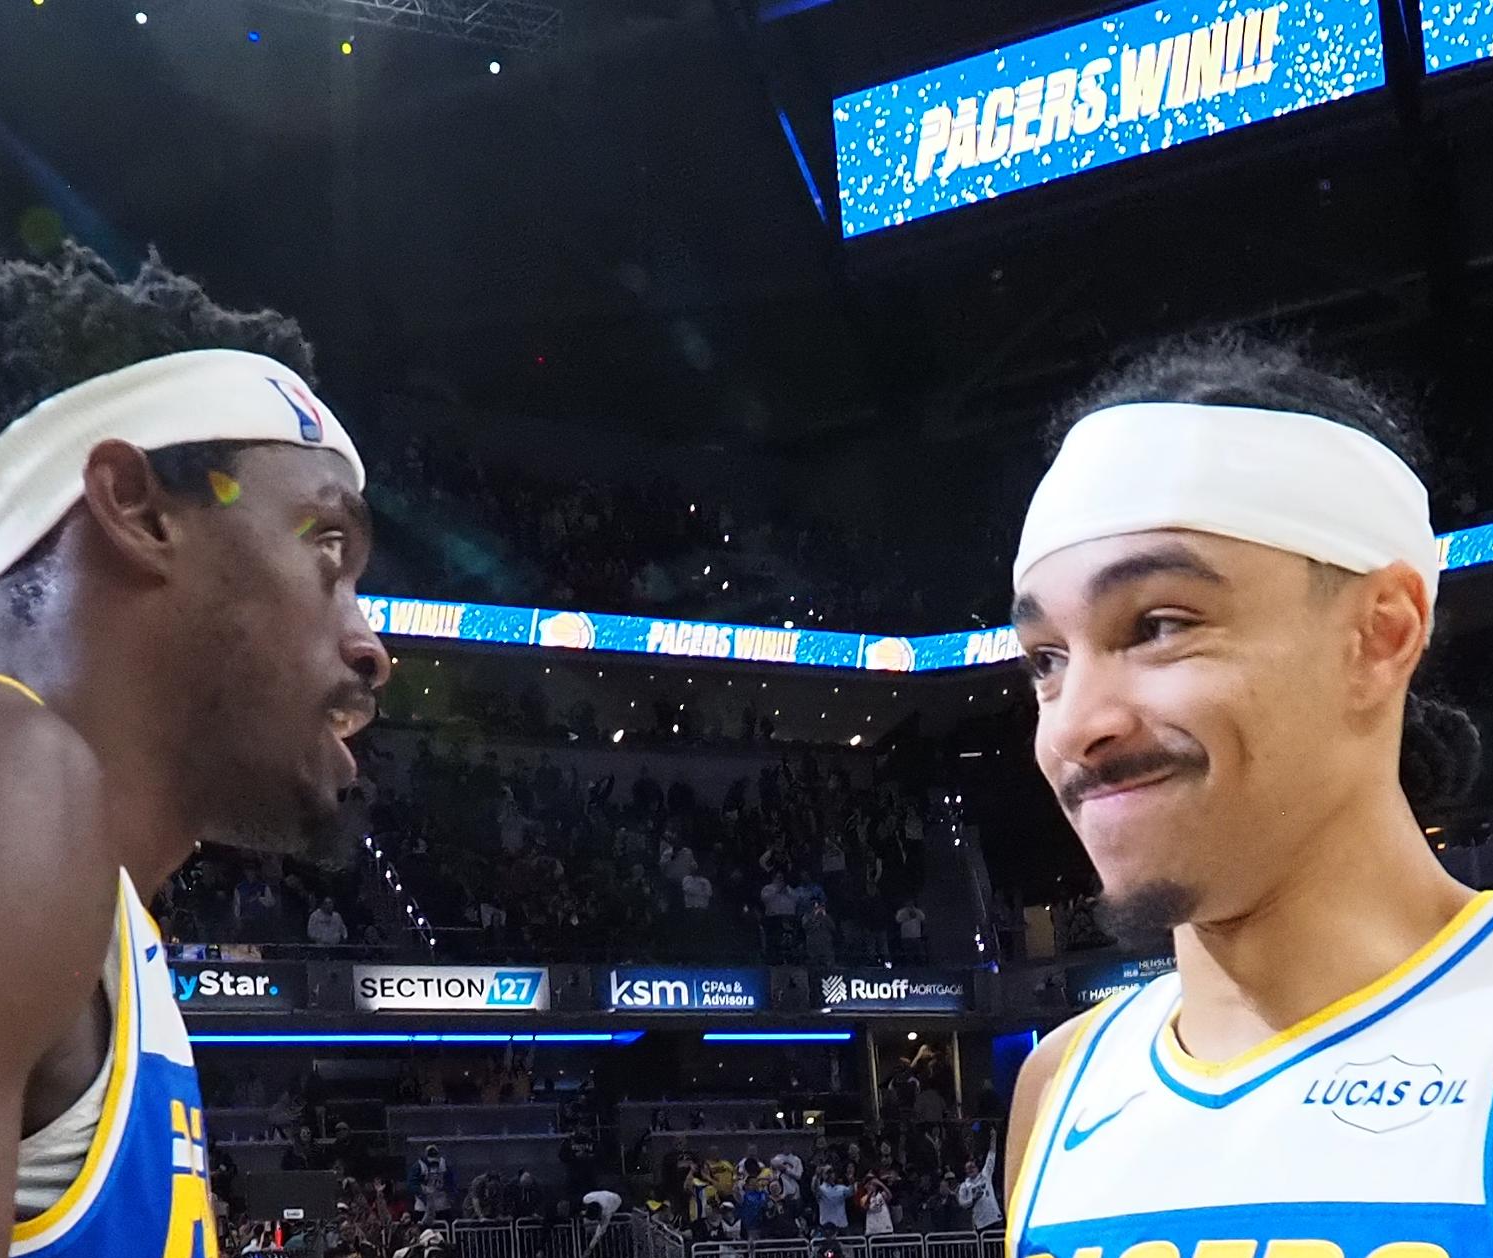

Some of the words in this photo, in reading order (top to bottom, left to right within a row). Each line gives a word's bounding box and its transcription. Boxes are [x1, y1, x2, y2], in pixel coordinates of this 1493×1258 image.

[914, 57, 1111, 183] PACERS
[1118, 6, 1281, 122] WIN!!!
[646, 621, 733, 658] PACERS
[734, 628, 800, 662] WIN!!!
[360, 977, 486, 999] SECTION
[490, 977, 531, 1002] 127
[610, 970, 689, 1006] ksm
[702, 981, 733, 994] CPAs
[702, 993, 755, 1007] Advisors
[851, 979, 909, 1000] Ruoff
[1302, 1079, 1411, 1106] LUCAS
[1419, 1079, 1468, 1106] OIL
